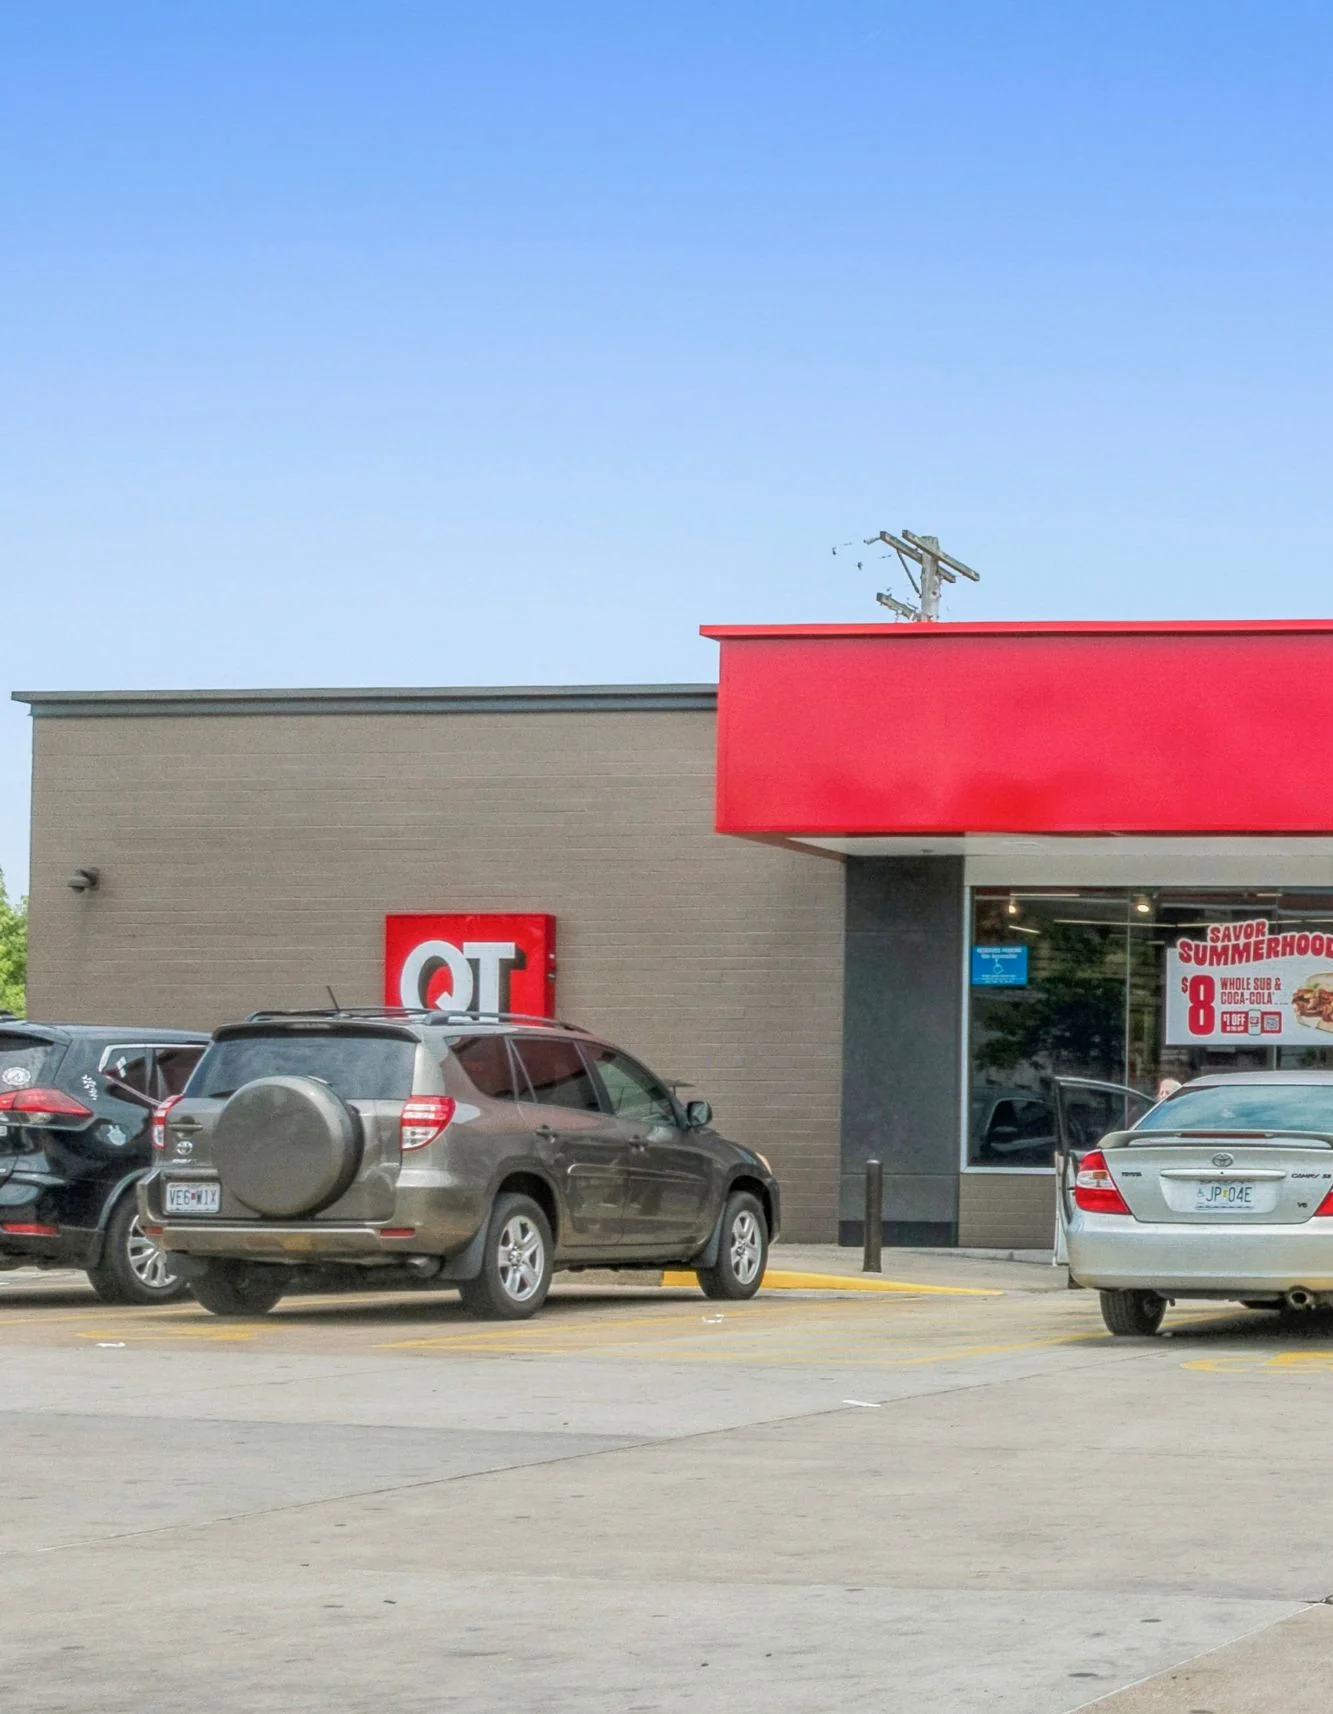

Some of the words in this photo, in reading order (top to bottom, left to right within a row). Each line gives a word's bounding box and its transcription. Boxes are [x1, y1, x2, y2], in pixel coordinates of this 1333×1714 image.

[1209, 921, 1267, 943] SAVOR
[400, 940, 516, 1022] QT
[1220, 977, 1251, 990] WHOLE
[1253, 977, 1272, 990] SUB
[1274, 977, 1281, 990] &
[1221, 991, 1273, 1005] COCA-COLA
[1231, 1014, 1245, 1025] OFF
[1206, 1186, 1222, 1202] JP
